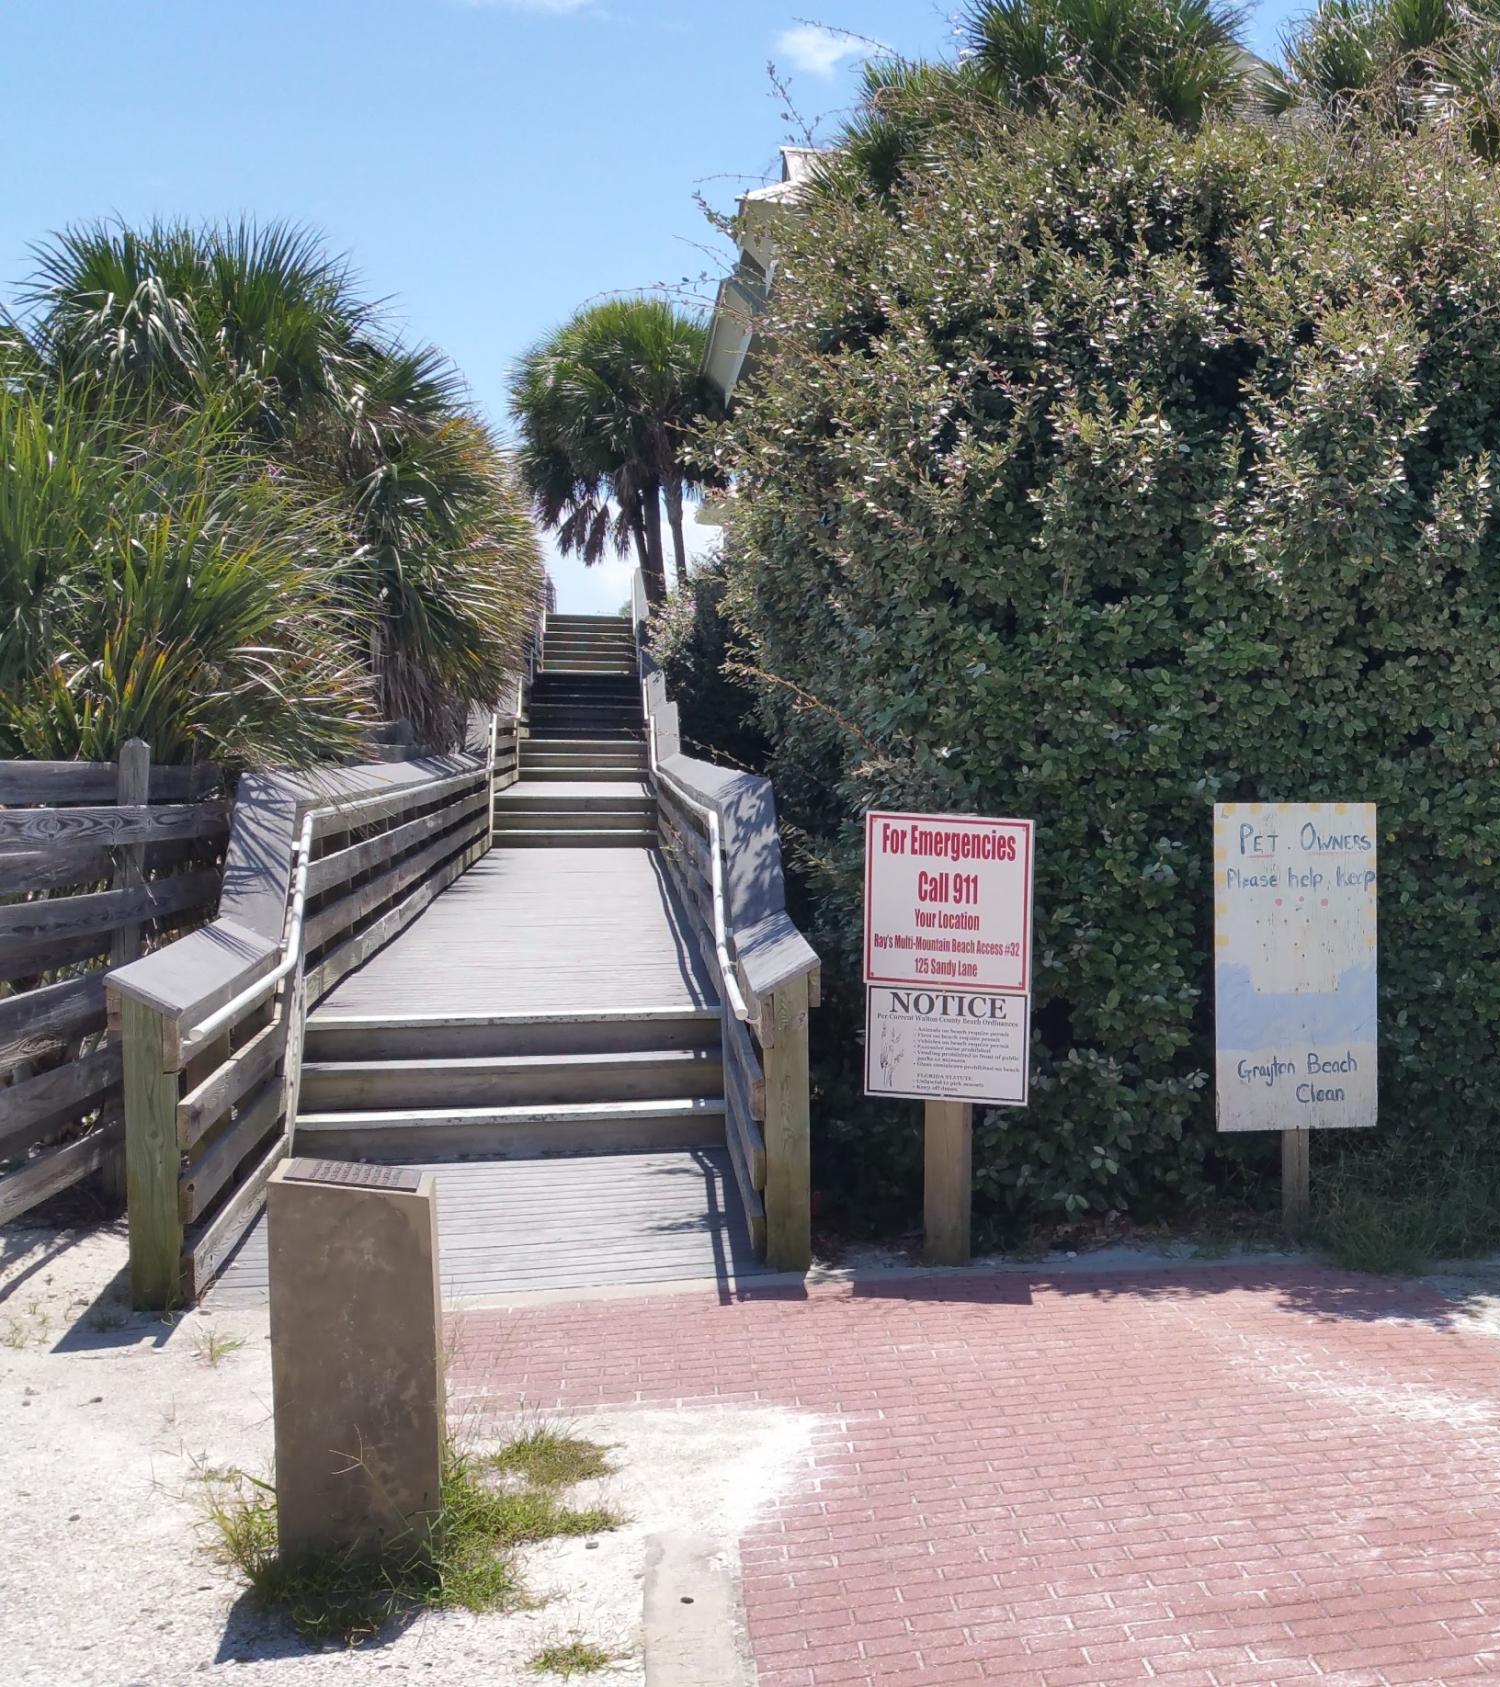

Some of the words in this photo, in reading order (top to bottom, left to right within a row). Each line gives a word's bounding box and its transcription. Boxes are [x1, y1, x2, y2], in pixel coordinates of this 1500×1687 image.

[882, 823, 906, 854] For
[911, 825, 1016, 861] Emergencies
[1239, 823, 1279, 855] PET
[1301, 822, 1372, 850] OWNERS
[918, 871, 949, 903] Call
[953, 873, 978, 904] 911
[1227, 868, 1279, 888] Please
[1288, 867, 1323, 889] help
[1336, 866, 1376, 892] keep
[915, 909, 936, 928] Your
[939, 910, 979, 930] Location
[875, 934, 893, 949] Ray's
[895, 934, 950, 952] Multi-Mountain
[952, 939, 974, 953] Beach
[976, 940, 1003, 955] Access
[1004, 942, 1019, 956] #32
[915, 958, 928, 974] 125
[931, 958, 956, 977] Sandy
[958, 961, 977, 977] Lane
[889, 992, 1007, 1019] NOTICE
[939, 1016, 960, 1024] County
[1238, 1056, 1295, 1087] Grayton
[1307, 1050, 1358, 1073] Beach
[1296, 1083, 1345, 1103] Clean
